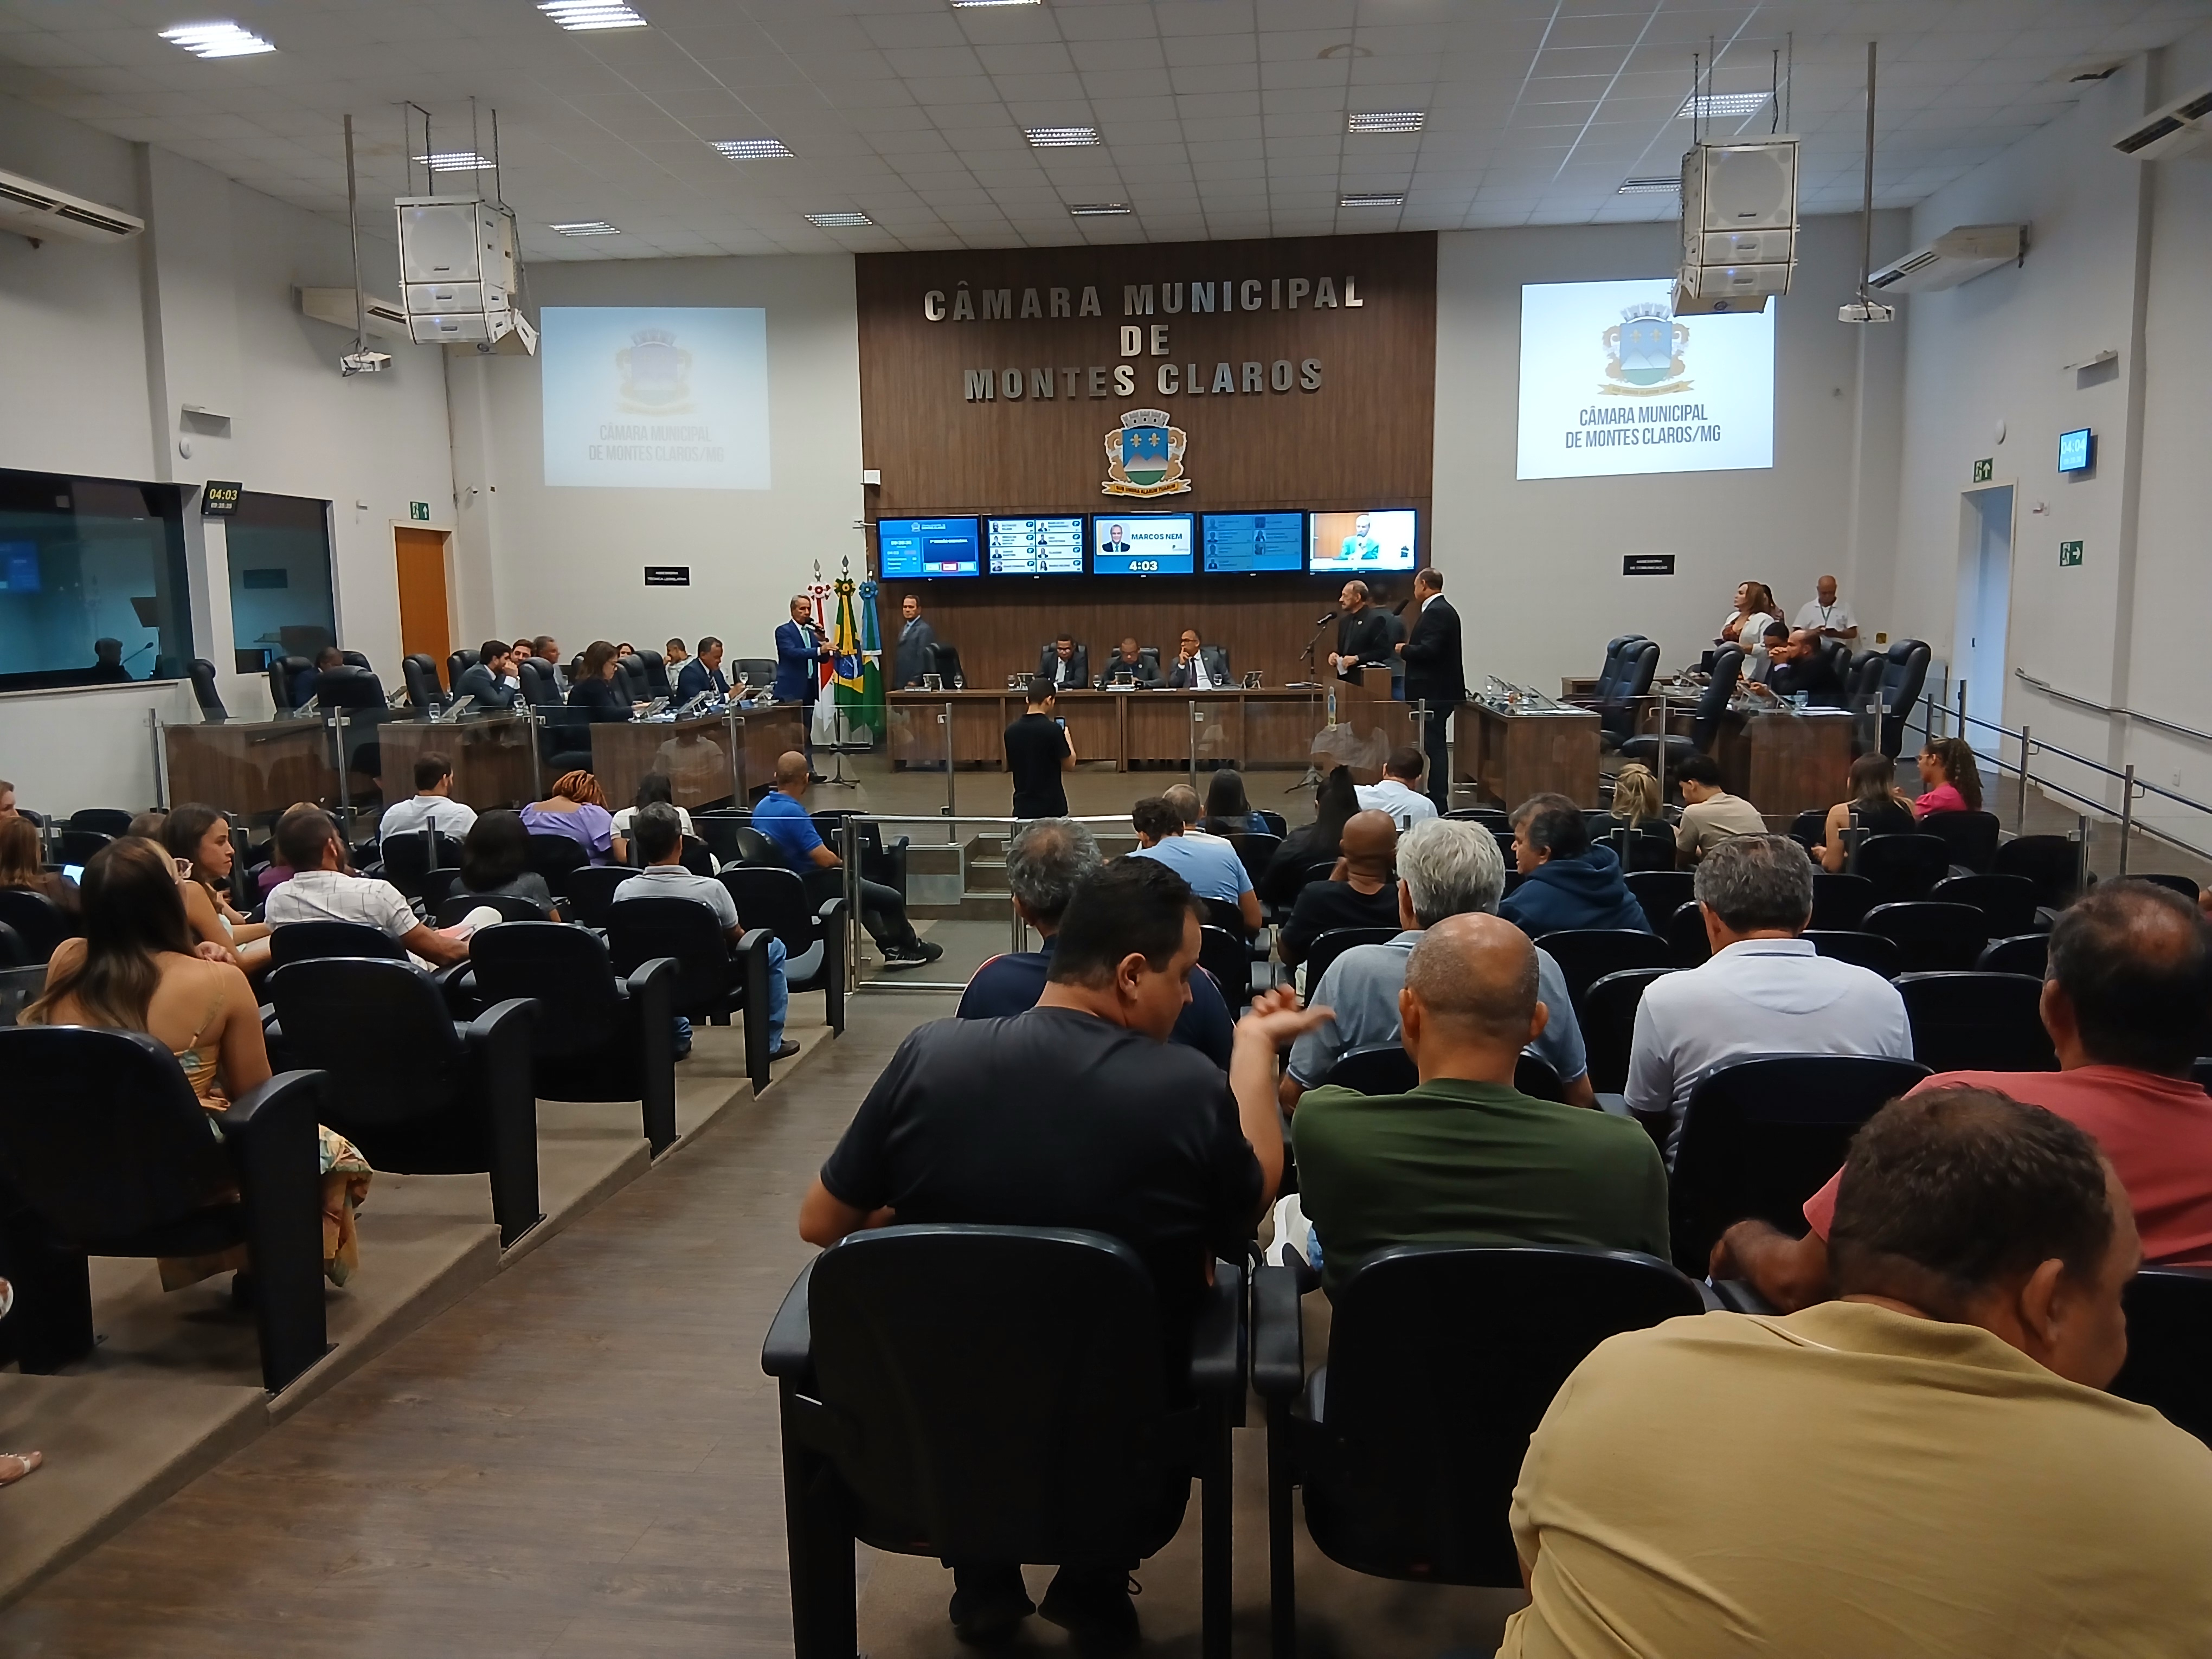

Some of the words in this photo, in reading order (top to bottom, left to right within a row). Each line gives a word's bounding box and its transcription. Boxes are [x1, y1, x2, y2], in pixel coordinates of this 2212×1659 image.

[924, 280, 1102, 321] CÂMARA
[1124, 275, 1364, 316] MUNICIPAL
[1120, 324, 1169, 357] DE
[964, 365, 1135, 400] MONTES
[1158, 359, 1322, 395] CLAROS
[1579, 405, 1635, 426] CÂMARA
[1638, 404, 1708, 423] MUNICIPAL
[600, 422, 648, 441] CÂMARA
[651, 425, 712, 442] MUNICIPAL
[1565, 431, 1583, 448] DE
[1586, 428, 1639, 447] MONTES
[1642, 425, 1721, 445] CLAROS/MG
[589, 445, 603, 461] DE
[606, 445, 653, 461] MONTES
[655, 446, 724, 463] CLAROS/MG
[2061, 438, 2086, 454] 04:04
[209, 488, 237, 500] 04:03
[1129, 561, 1158, 571] 4:03
